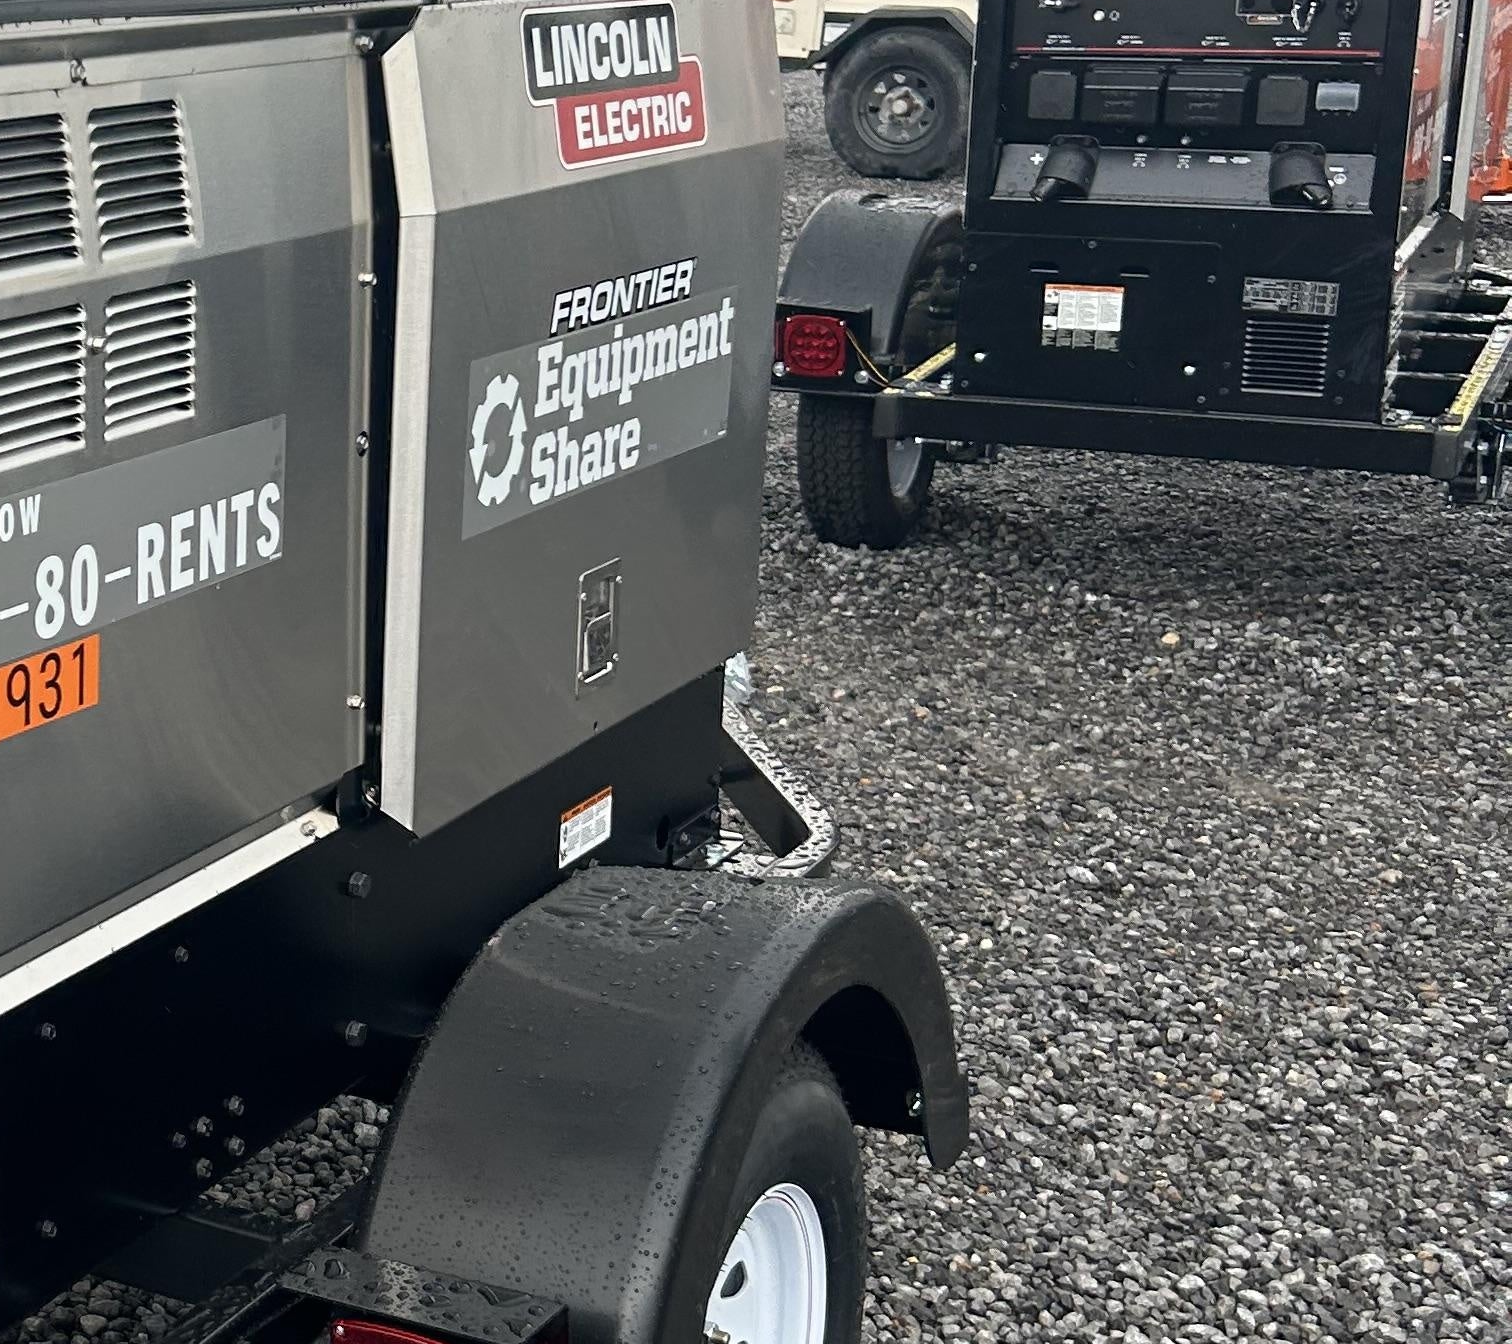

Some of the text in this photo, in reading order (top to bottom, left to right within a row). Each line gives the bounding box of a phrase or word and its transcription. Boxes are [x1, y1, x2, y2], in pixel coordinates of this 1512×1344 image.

[531, 16, 672, 87] LINCOLN
[574, 90, 693, 150] ELECTRIC
[551, 260, 693, 333] FRONTIER
[534, 297, 735, 419] Equipment
[529, 417, 640, 505] Share
